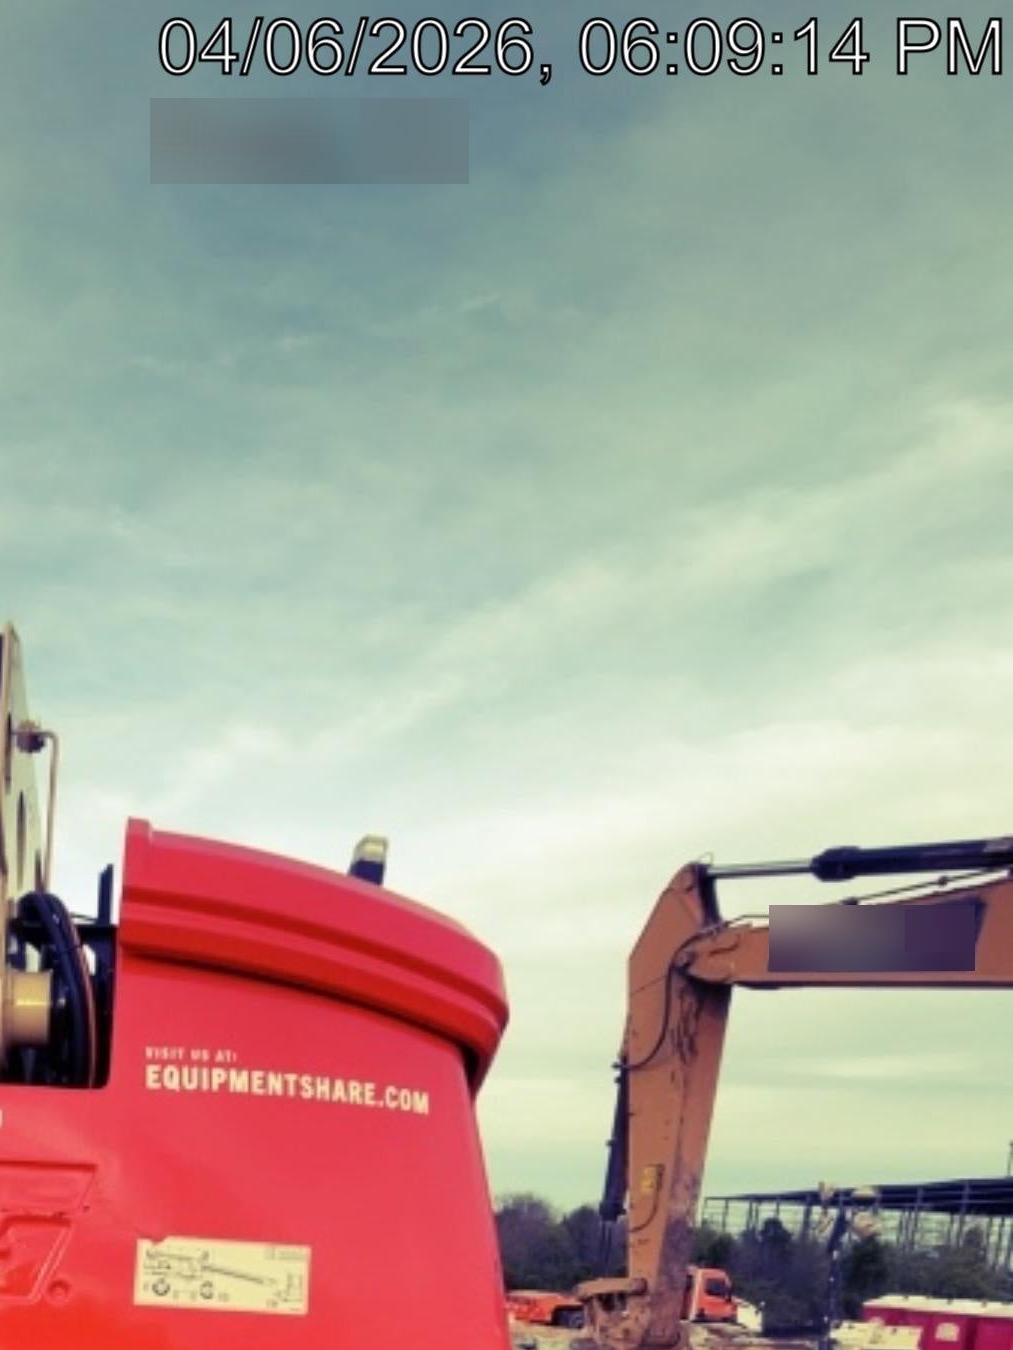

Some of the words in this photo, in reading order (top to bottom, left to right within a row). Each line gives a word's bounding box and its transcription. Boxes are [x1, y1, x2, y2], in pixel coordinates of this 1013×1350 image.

[145, 1046, 185, 1060] VISIT
[190, 1049, 210, 1062] US
[145, 1063, 429, 1116] EQUIPMENTSHARE.COM
